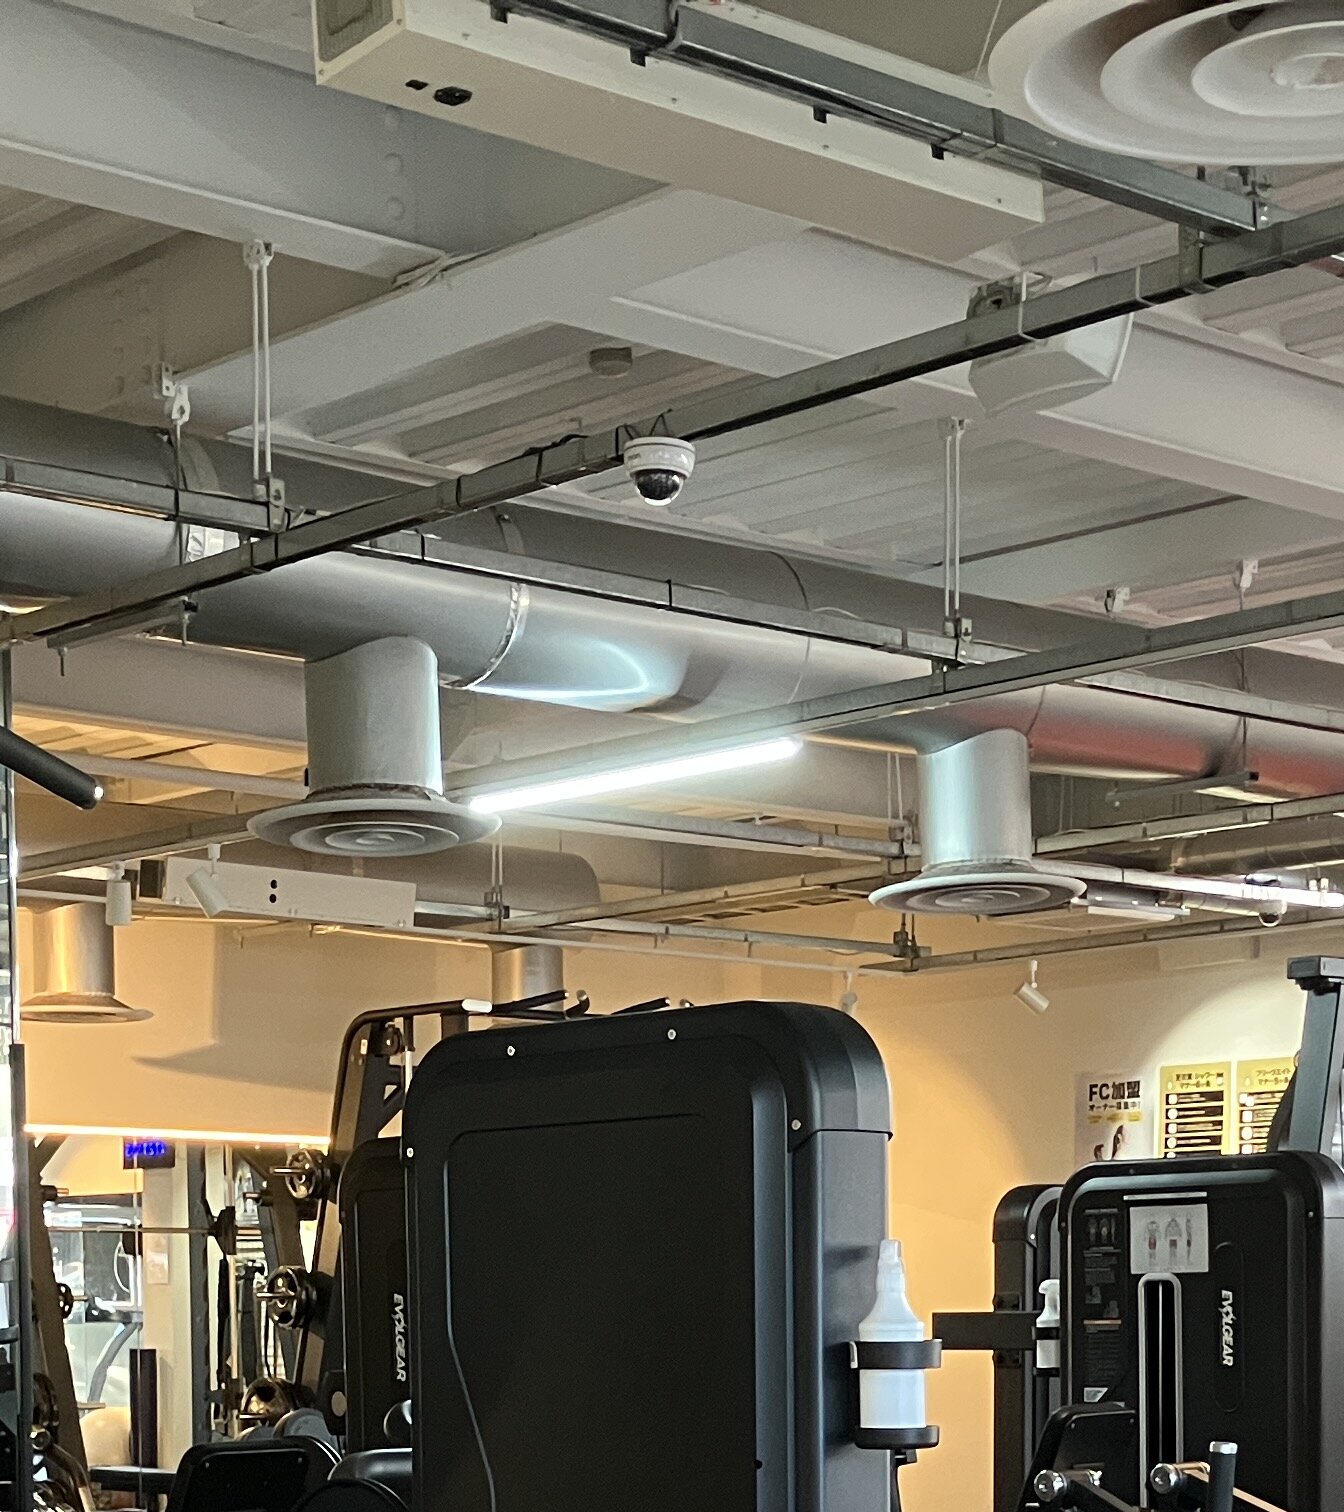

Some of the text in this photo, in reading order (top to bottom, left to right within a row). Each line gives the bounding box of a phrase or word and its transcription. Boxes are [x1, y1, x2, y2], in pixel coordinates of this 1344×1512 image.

[1089, 1080, 1141, 1102] FC加盟
[391, 1293, 407, 1382] EVOLGEAR
[1218, 1289, 1237, 1367] EVOLGEAR
